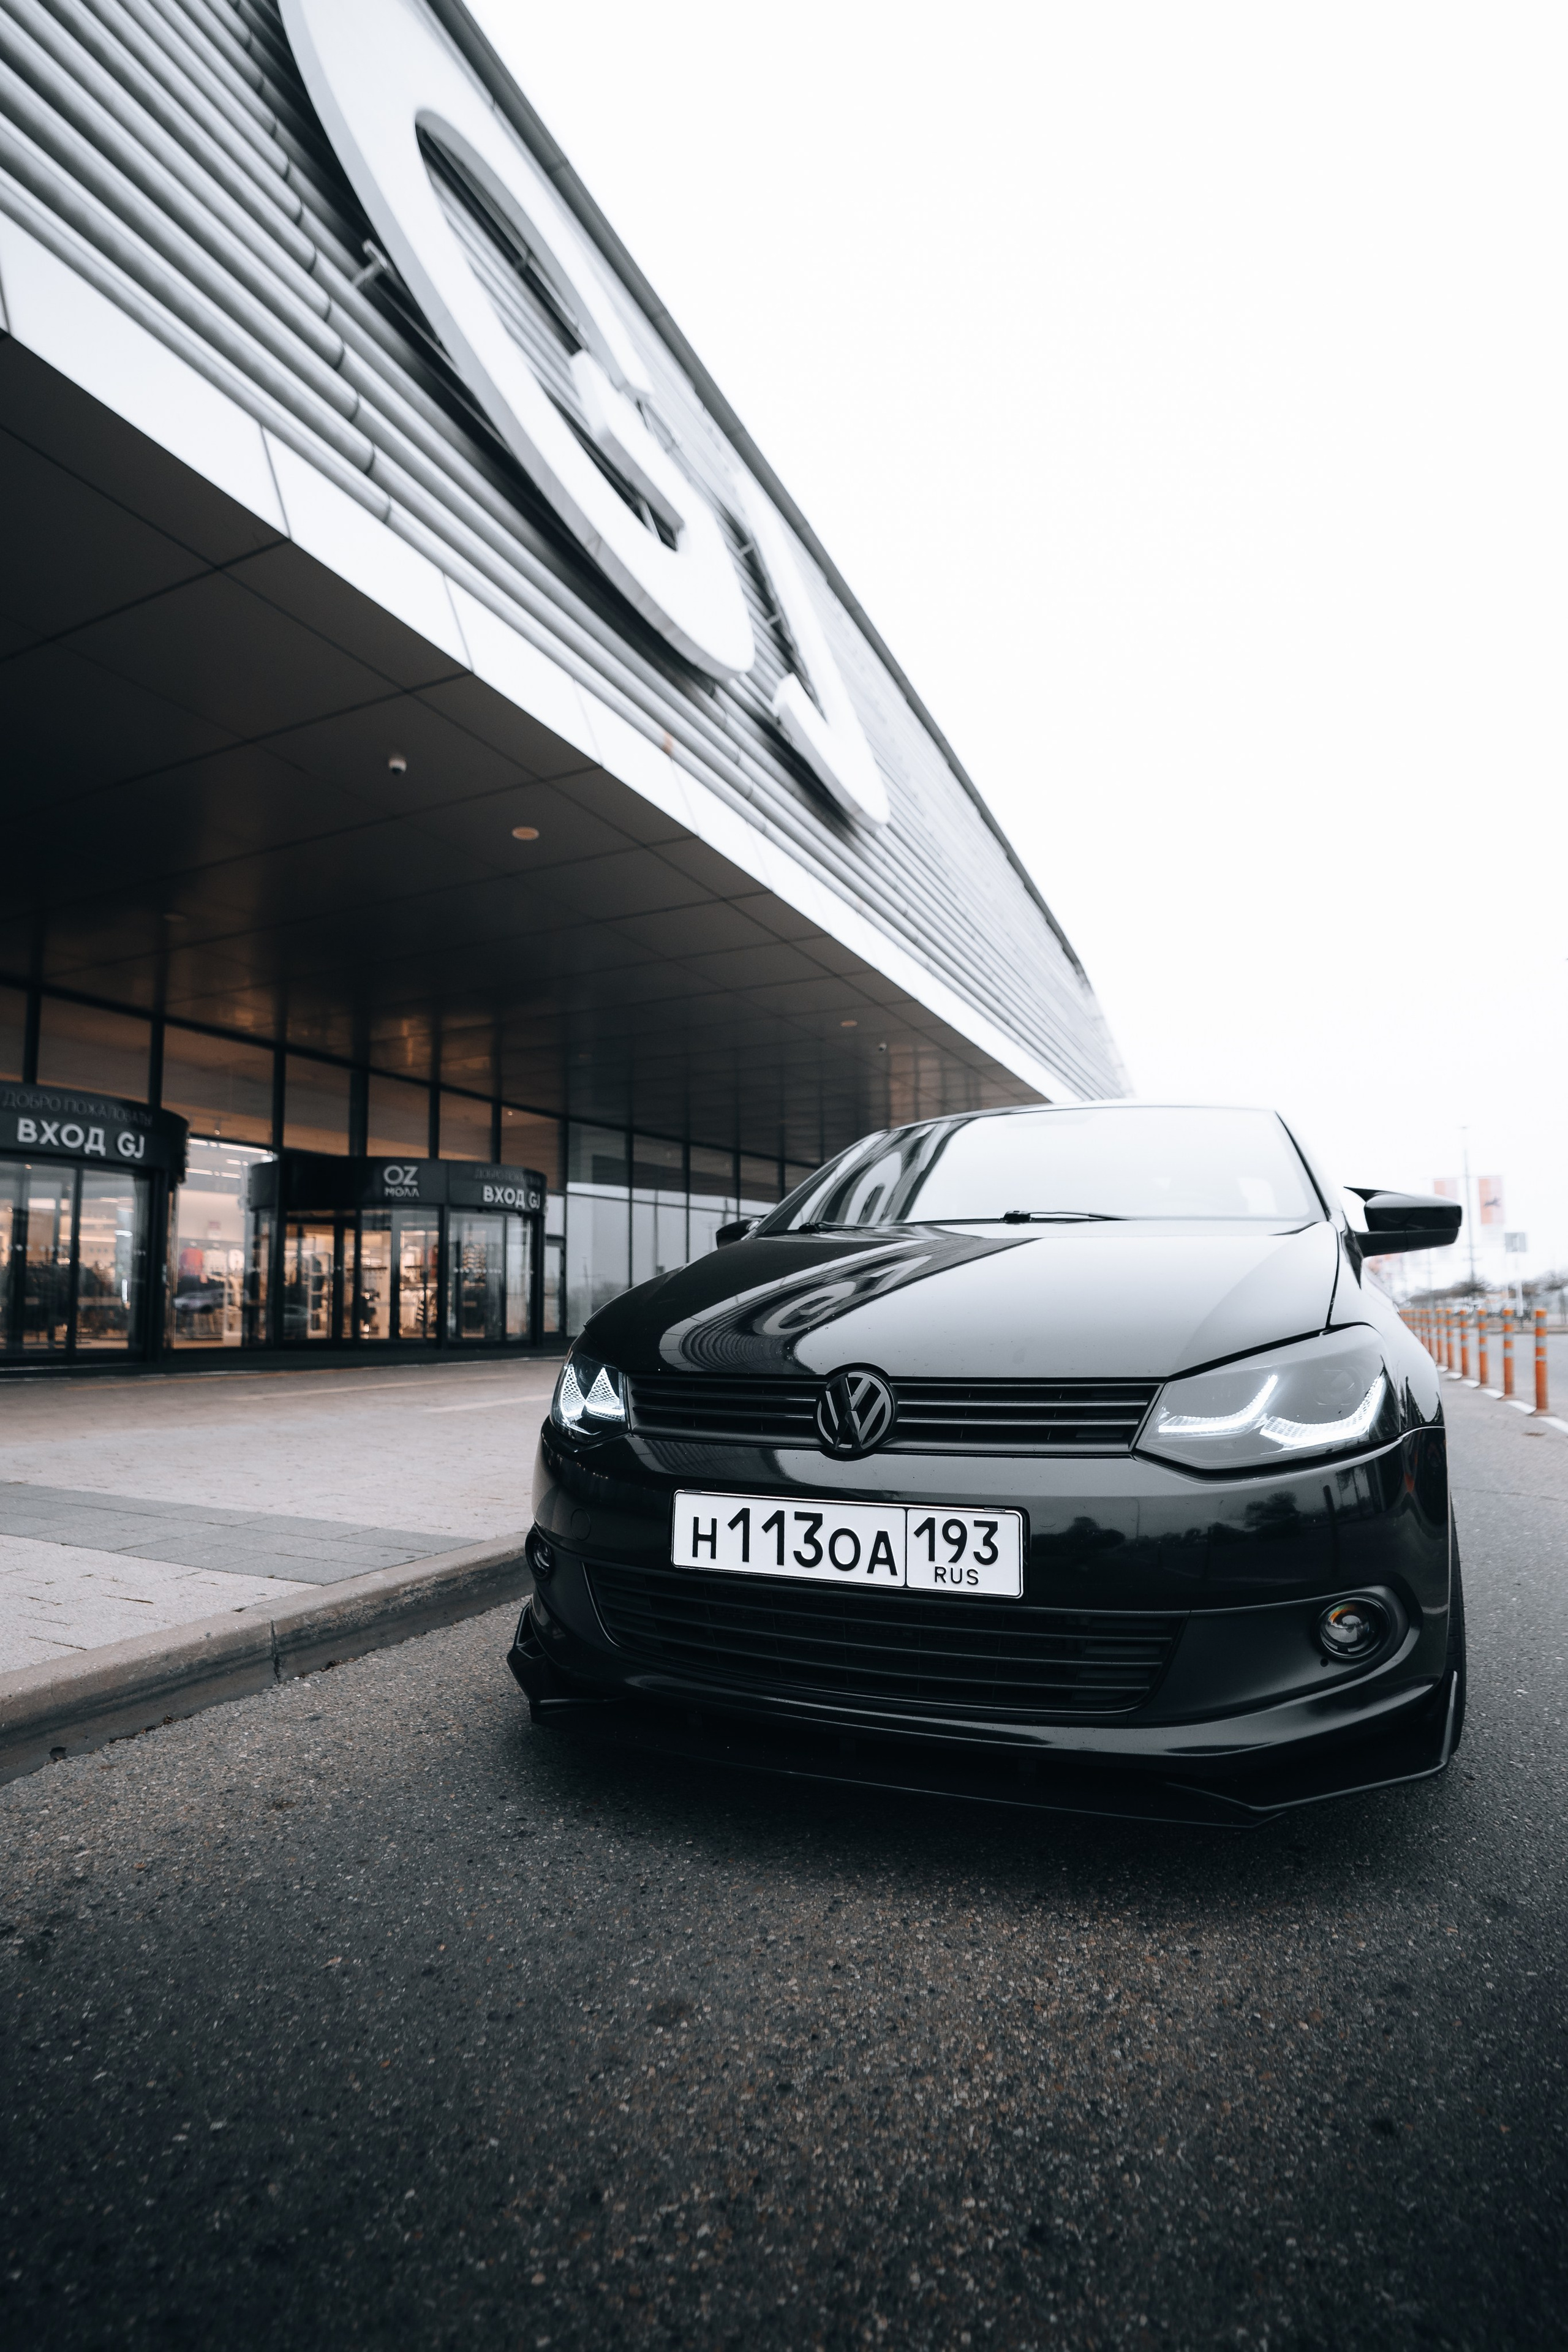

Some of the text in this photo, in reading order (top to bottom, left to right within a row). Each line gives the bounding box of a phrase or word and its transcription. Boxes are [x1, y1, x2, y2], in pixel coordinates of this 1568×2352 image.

[2, 1090, 61, 1112] ДОБРО
[17, 1117, 145, 1159] ВХОД GJ
[383, 1164, 418, 1186] OZ
[383, 1186, 420, 1197] МОЛЛ
[483, 1185, 526, 1209] ВХОД
[913, 1517, 999, 1566] 193
[934, 1566, 979, 1585] RUS
